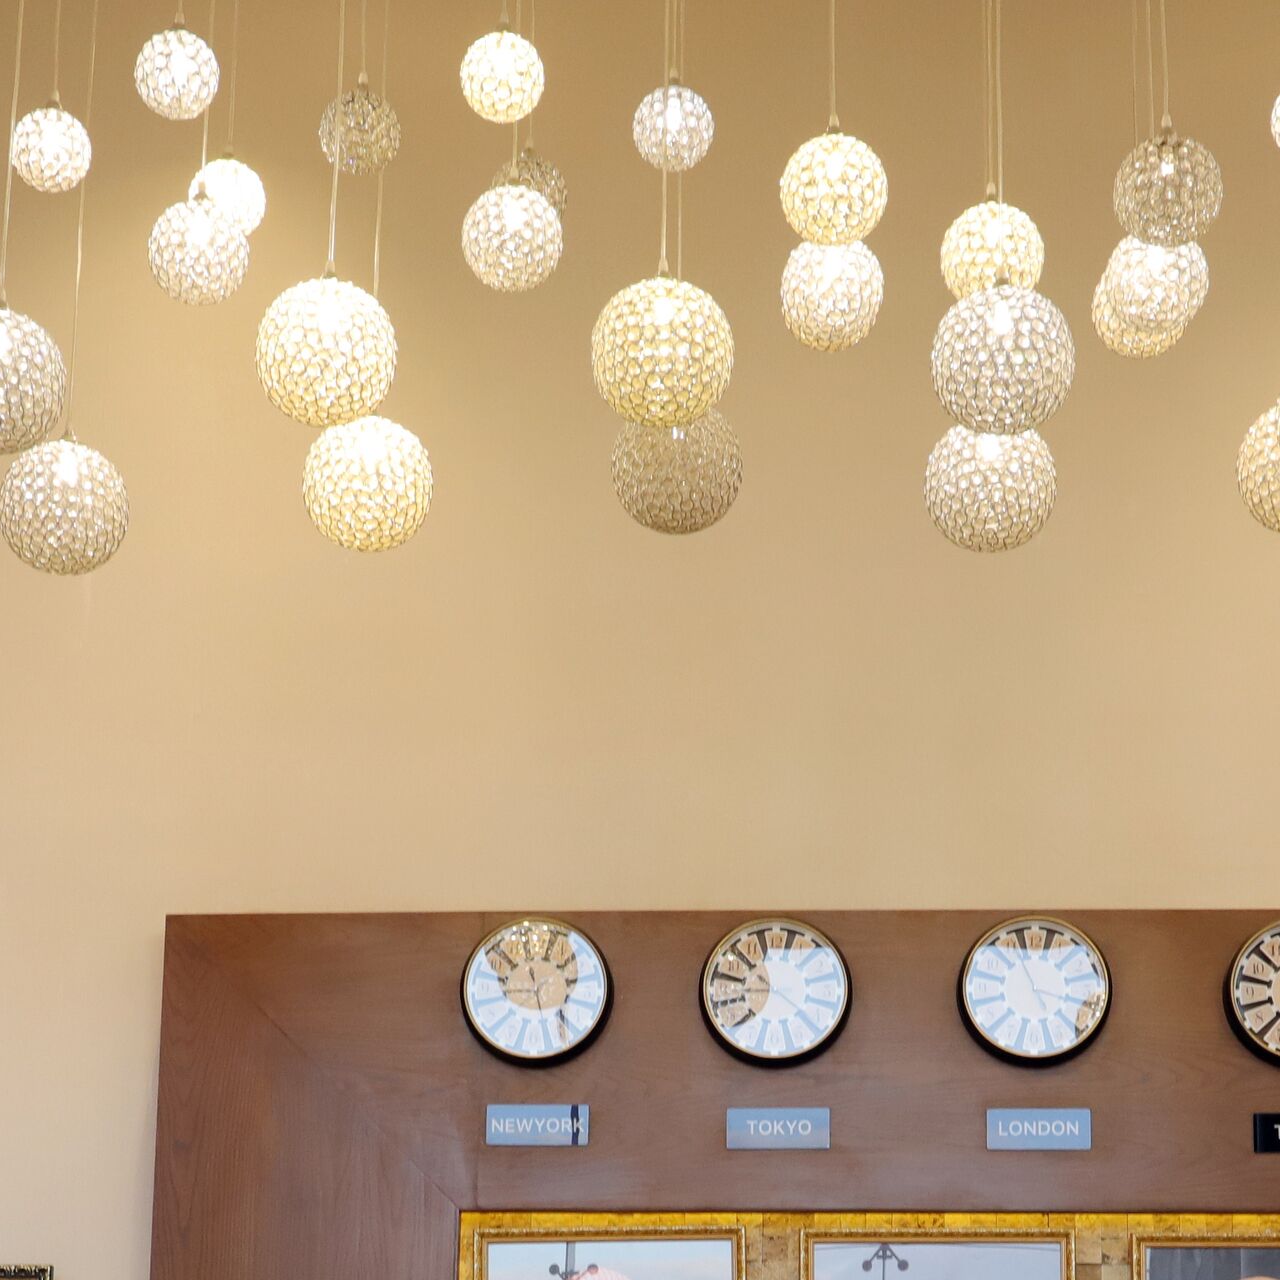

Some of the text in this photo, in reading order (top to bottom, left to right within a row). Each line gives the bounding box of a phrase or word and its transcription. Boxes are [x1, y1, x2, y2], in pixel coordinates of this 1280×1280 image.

[491, 1117, 585, 1134] NEWYORK
[746, 1119, 812, 1136] TOKYO
[998, 1120, 1079, 1137] LONDON
